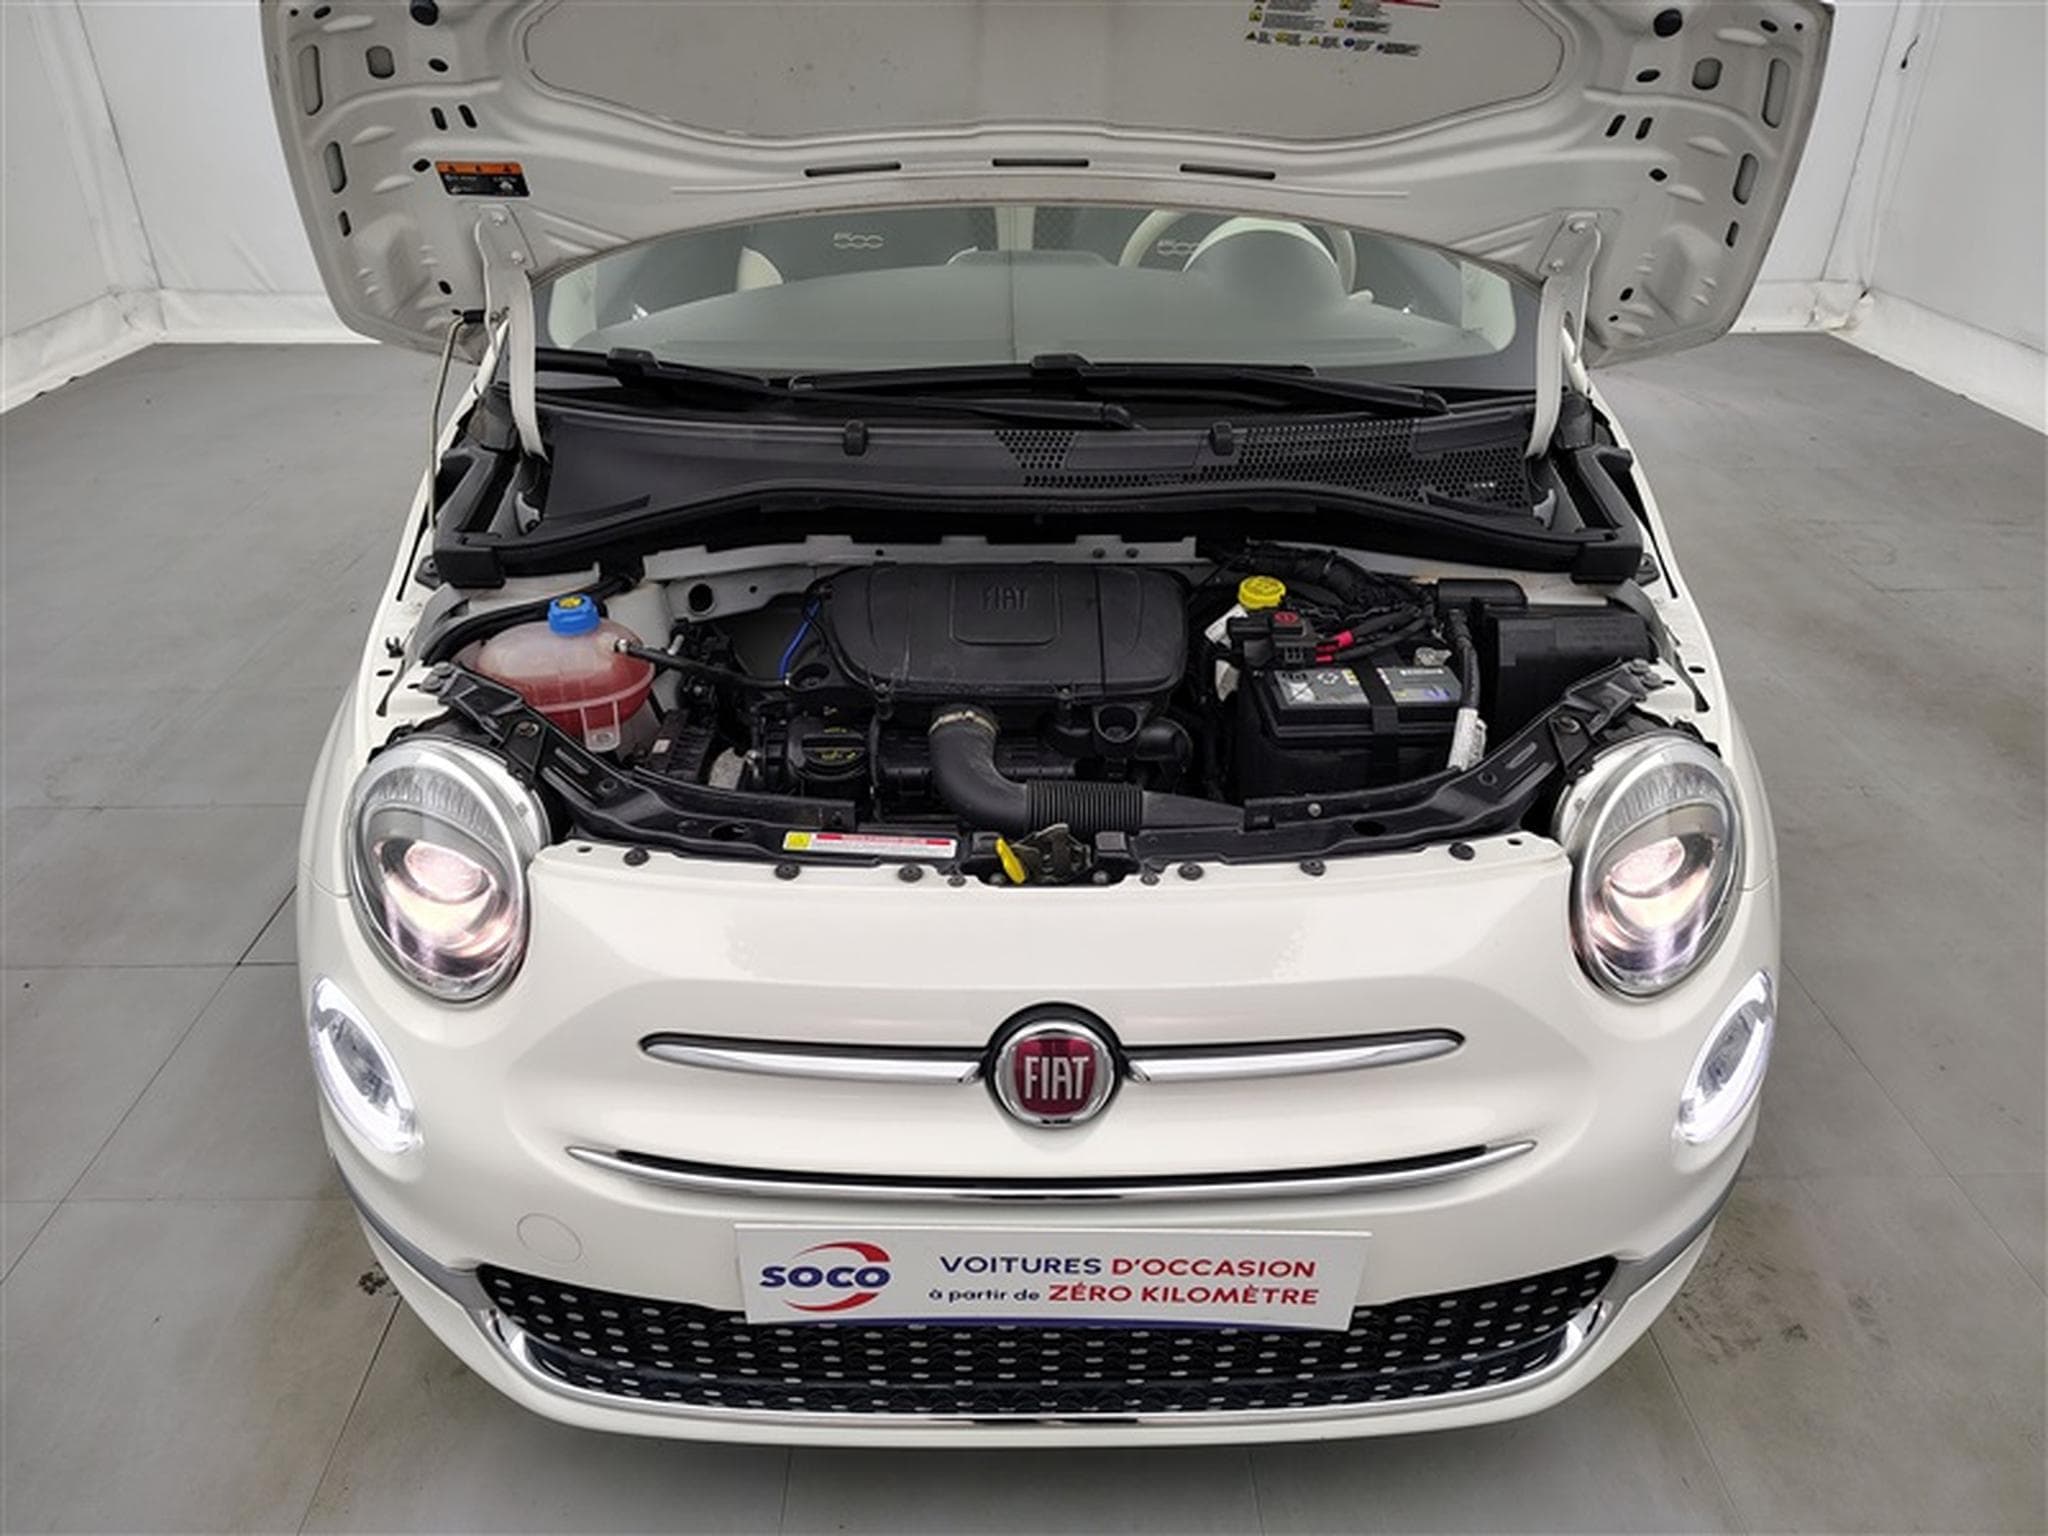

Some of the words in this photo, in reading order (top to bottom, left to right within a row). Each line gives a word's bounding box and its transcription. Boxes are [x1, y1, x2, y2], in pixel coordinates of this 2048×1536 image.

[1024, 1056, 1090, 1100] FIAT
[759, 1265, 891, 1288] SOCO
[939, 1255, 1102, 1274] VOITURES
[1111, 1258, 1317, 1279] D'OCCASION
[928, 1288, 943, 1301] à
[948, 1288, 1008, 1304] partir
[1013, 1289, 1040, 1301] de
[1048, 1281, 1133, 1302] ZÉRO
[1141, 1283, 1320, 1305] KILOMÈTRE
